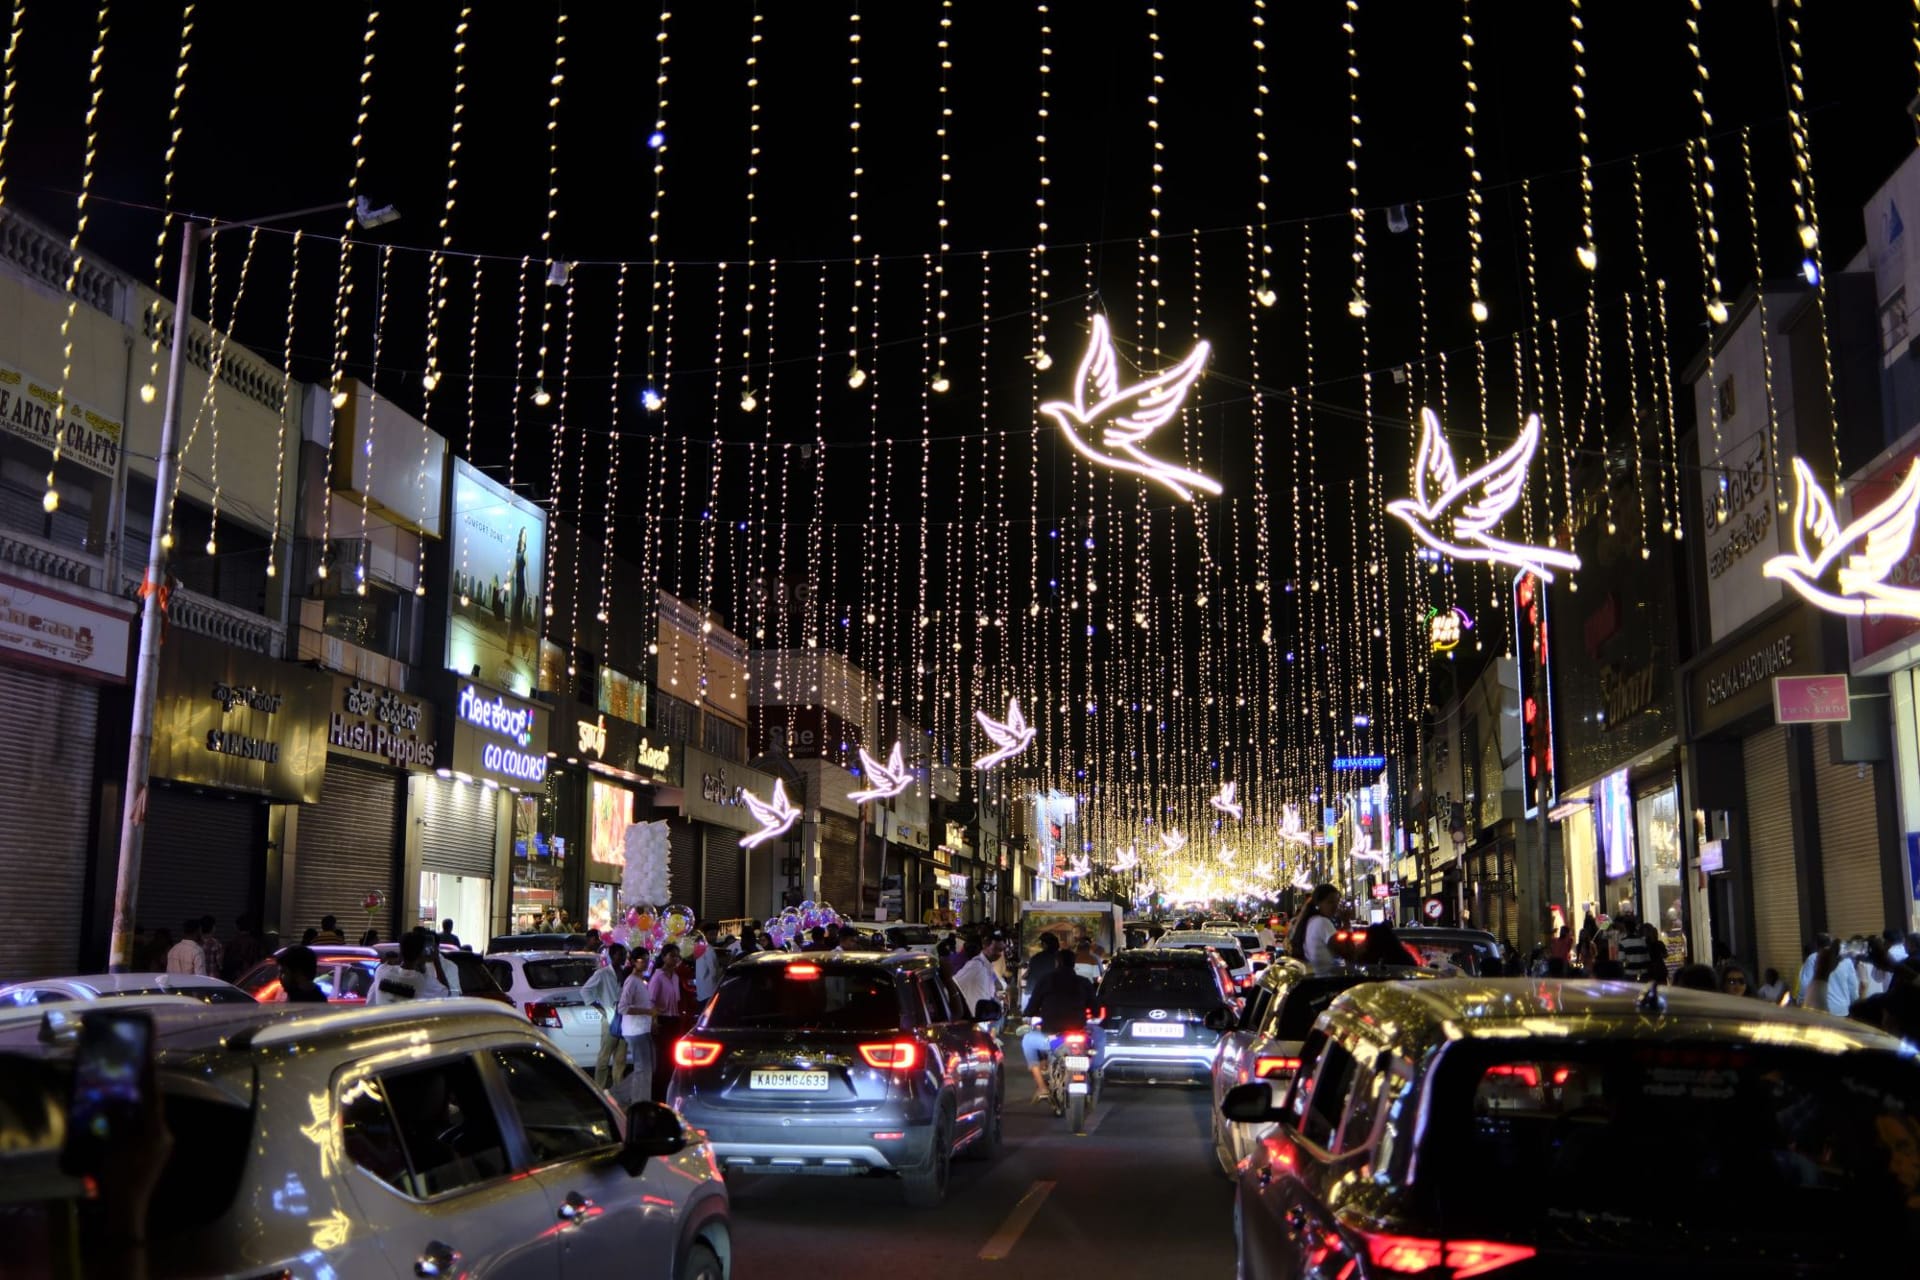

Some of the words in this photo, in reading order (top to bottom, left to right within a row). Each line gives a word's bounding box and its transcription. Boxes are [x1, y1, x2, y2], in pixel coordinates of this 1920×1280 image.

[12, 396, 51, 437] ARTS
[67, 421, 118, 467] CRAFTS
[1706, 667, 1739, 706] ASHOKA
[1739, 635, 1792, 688] HARDWARE
[208, 729, 279, 764] SAMSUNG
[330, 711, 373, 753] Hush
[376, 725, 435, 770] Puppies
[484, 743, 502, 770] GO
[502, 749, 547, 781] COLORS!
[757, 1074, 826, 1086] KA09MG4633
